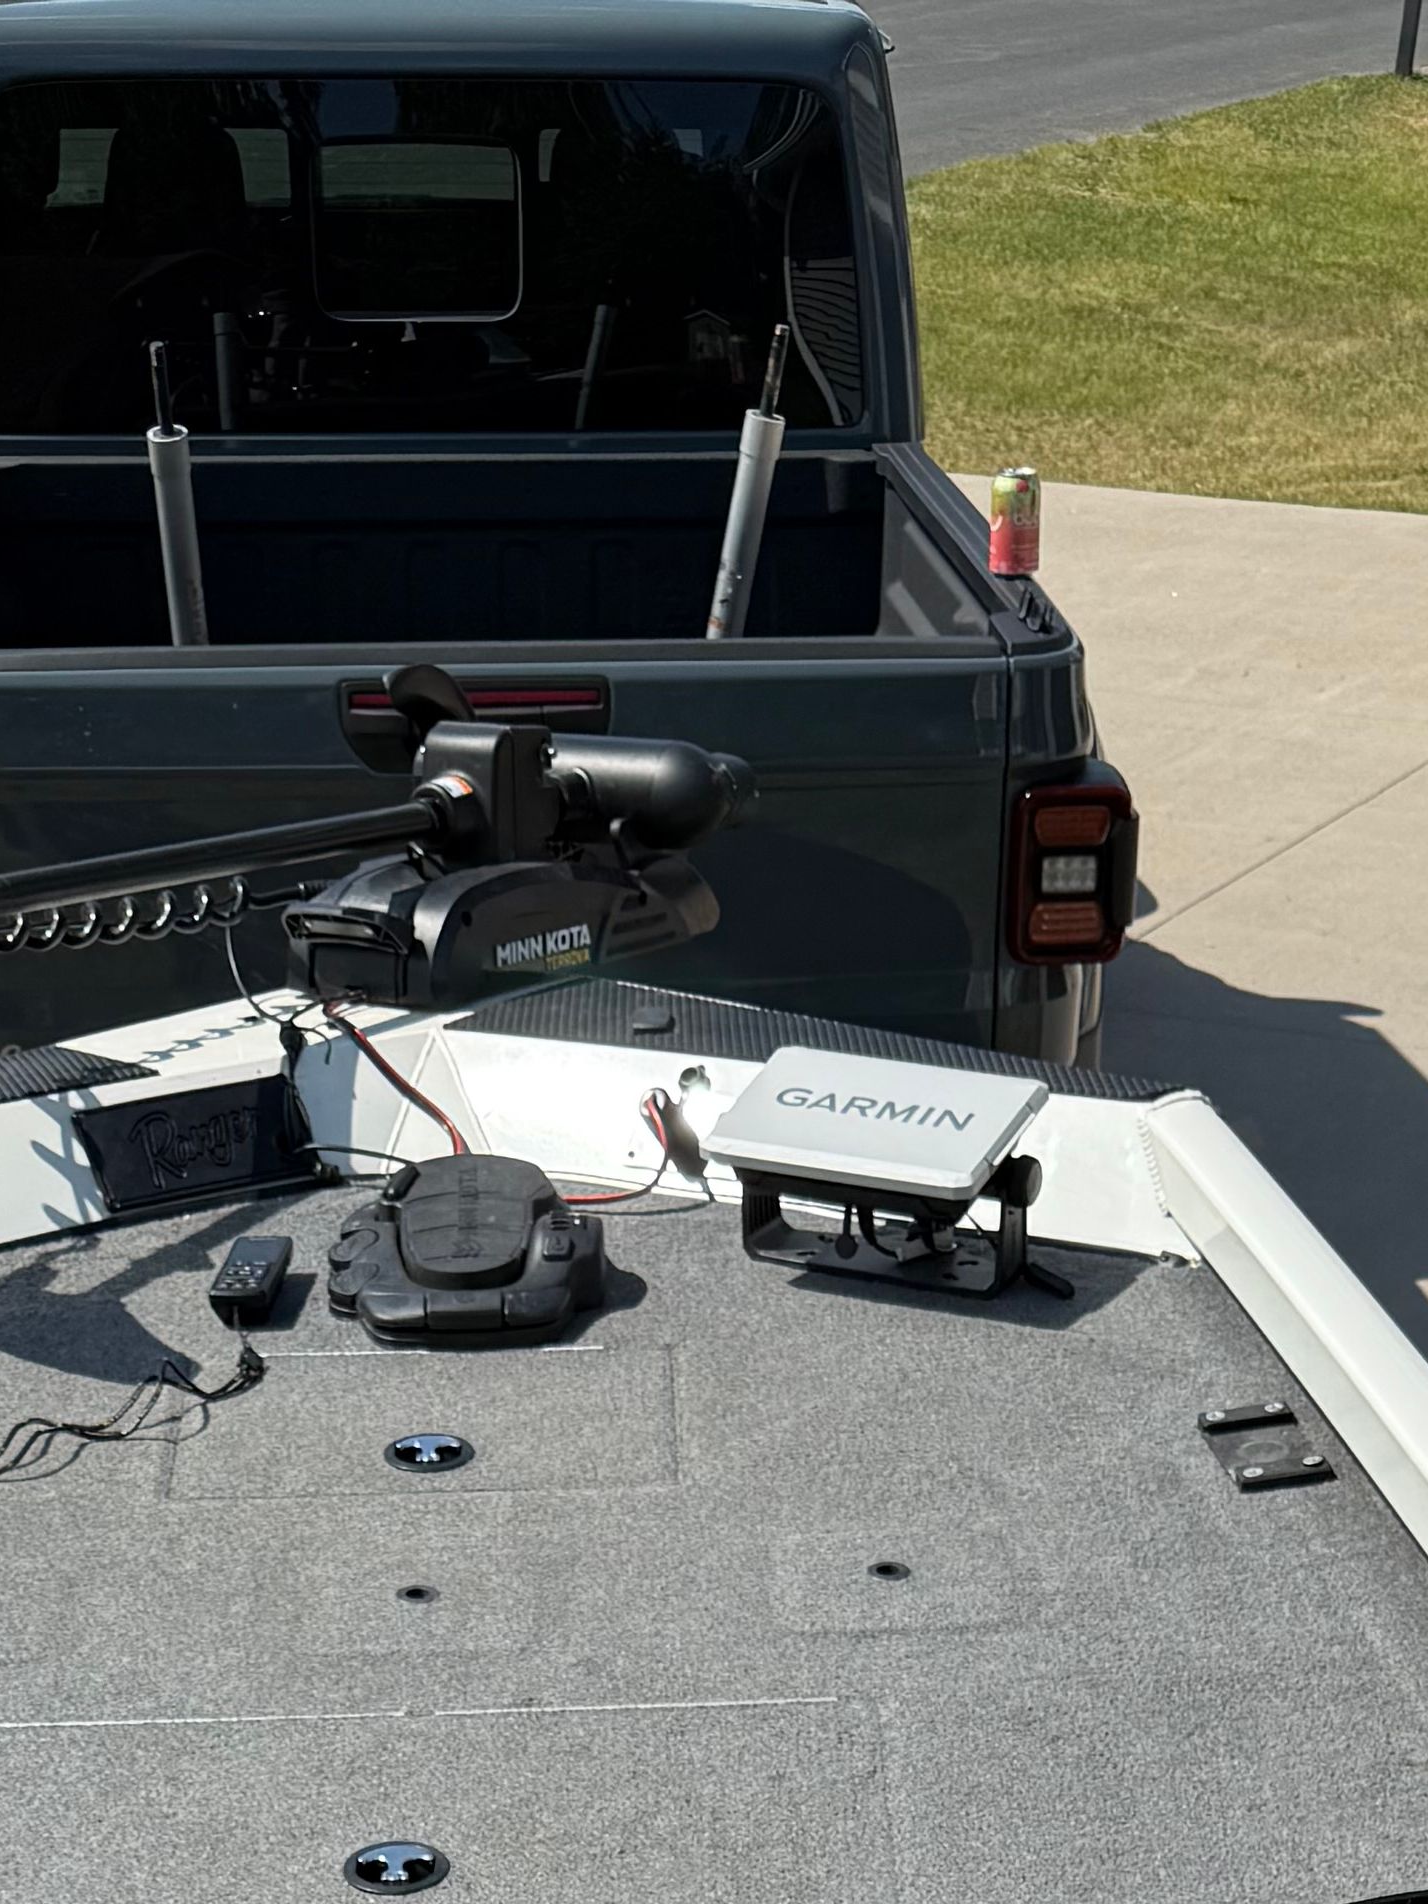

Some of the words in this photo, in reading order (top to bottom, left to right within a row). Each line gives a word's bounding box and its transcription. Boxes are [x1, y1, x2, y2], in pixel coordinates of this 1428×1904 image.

[495, 934, 543, 967] MINN
[544, 923, 592, 957] KOTA
[776, 1087, 976, 1132] GARMIN
[128, 1107, 259, 1190] Ranger
